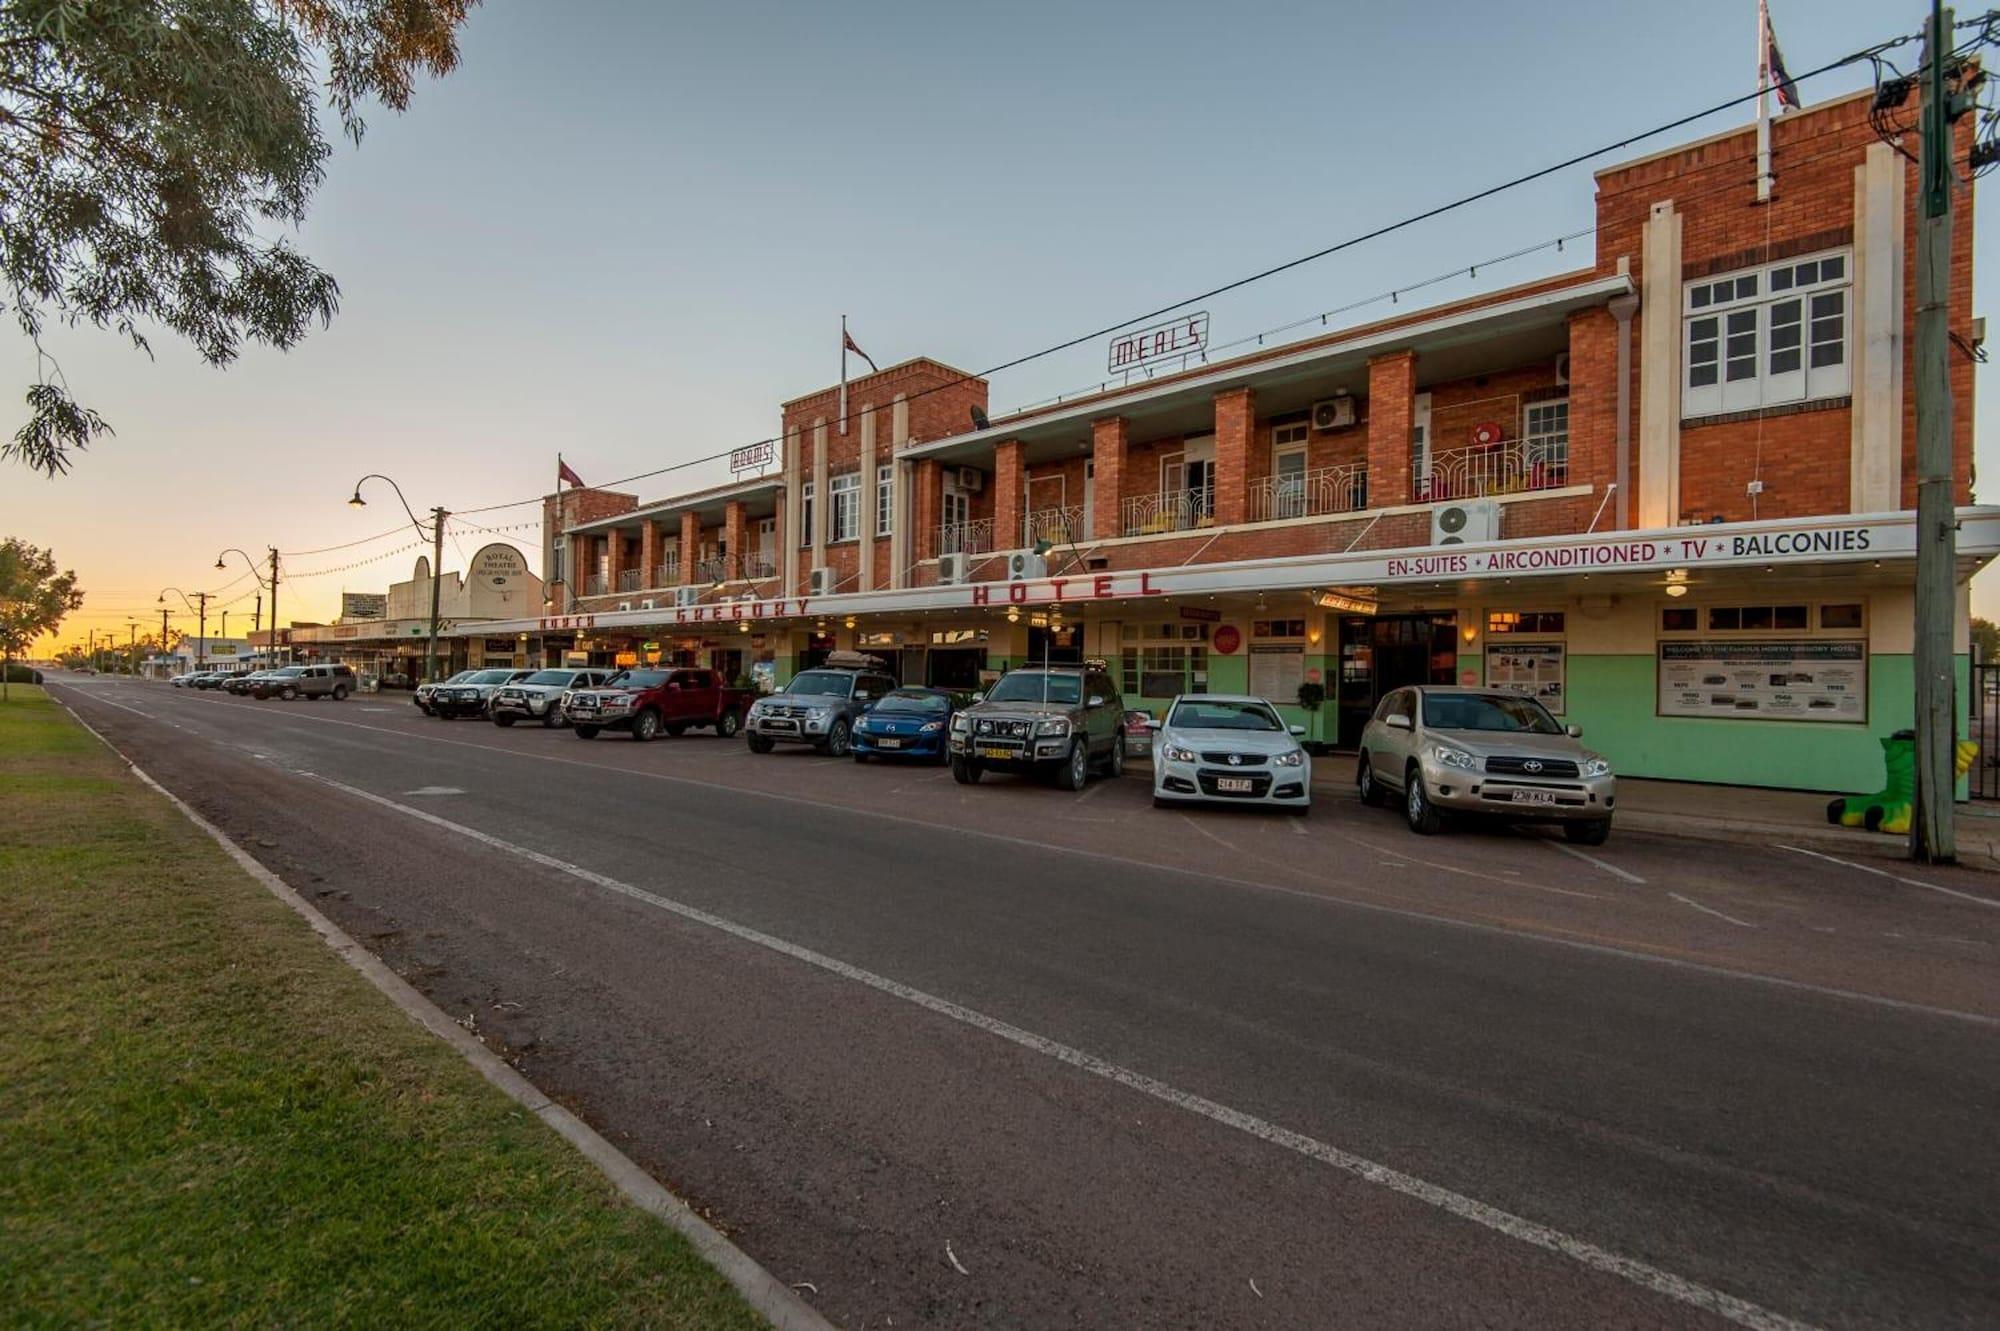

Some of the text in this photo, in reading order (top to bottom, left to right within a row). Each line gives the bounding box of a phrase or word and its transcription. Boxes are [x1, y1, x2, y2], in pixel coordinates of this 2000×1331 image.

[1116, 320, 1200, 366] MEALS
[733, 444, 770, 468] ROOMS
[486, 552, 513, 561] ROYAL
[1387, 529, 1870, 576] EN-SUITES AIRCONDITIONED TV BALCONIES
[540, 573, 1162, 629] NORTH GREGORY HOTEL
